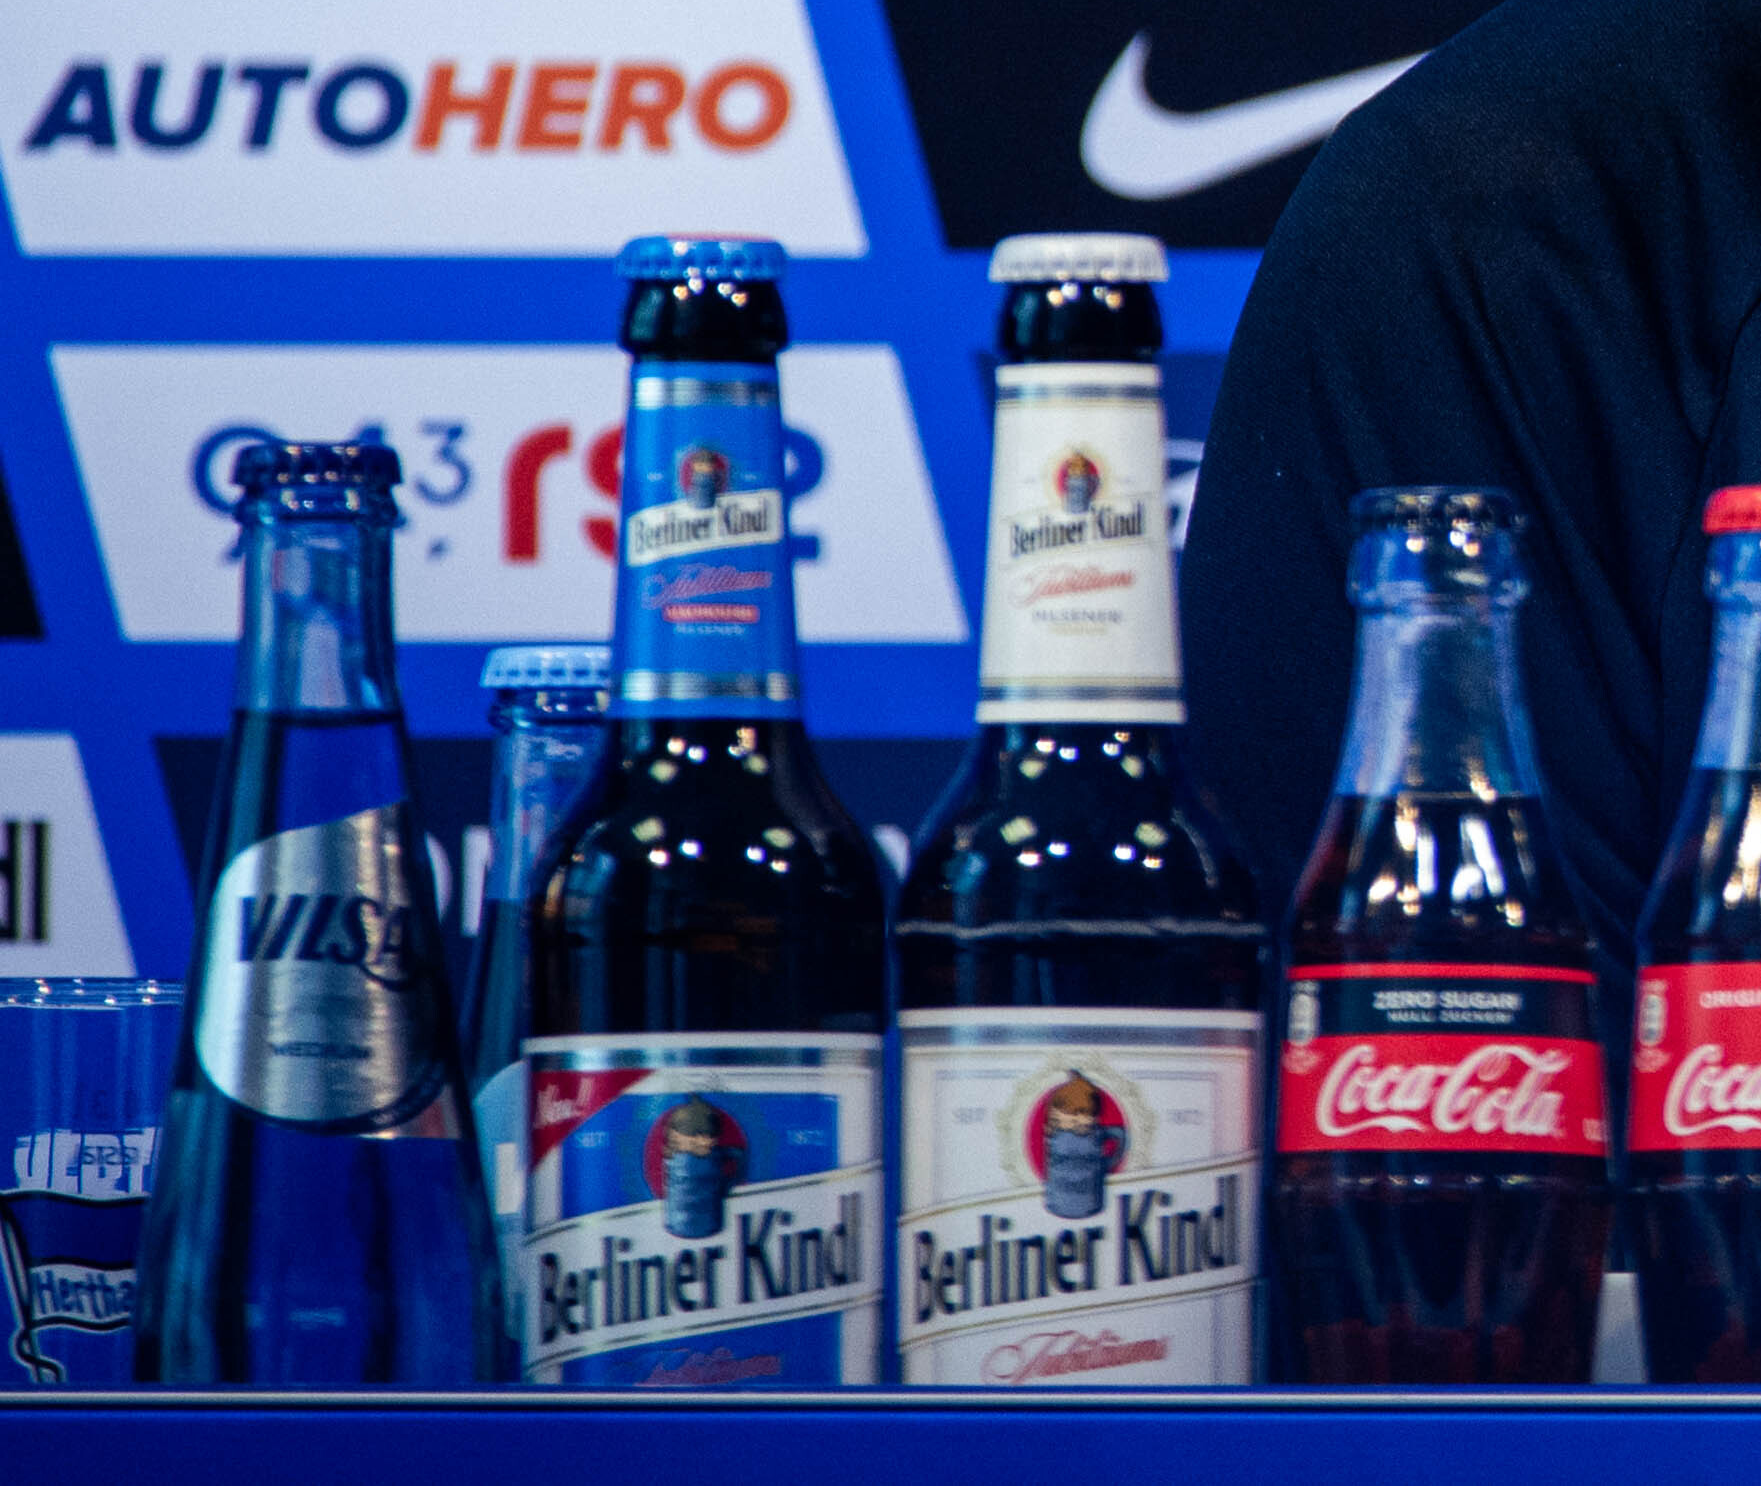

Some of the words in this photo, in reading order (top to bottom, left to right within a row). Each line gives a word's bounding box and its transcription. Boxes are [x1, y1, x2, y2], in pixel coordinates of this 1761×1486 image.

[22, 59, 792, 154] AUTOHERO
[1372, 990, 1438, 1010] ZERO
[1439, 991, 1523, 1011] SUGAR
[1315, 1042, 1572, 1138] Coca-Cola
[539, 1235, 727, 1344] Berliner
[737, 1192, 863, 1305] Kindl
[914, 1215, 1107, 1325] Berliner
[1115, 1173, 1240, 1287] Kindl
